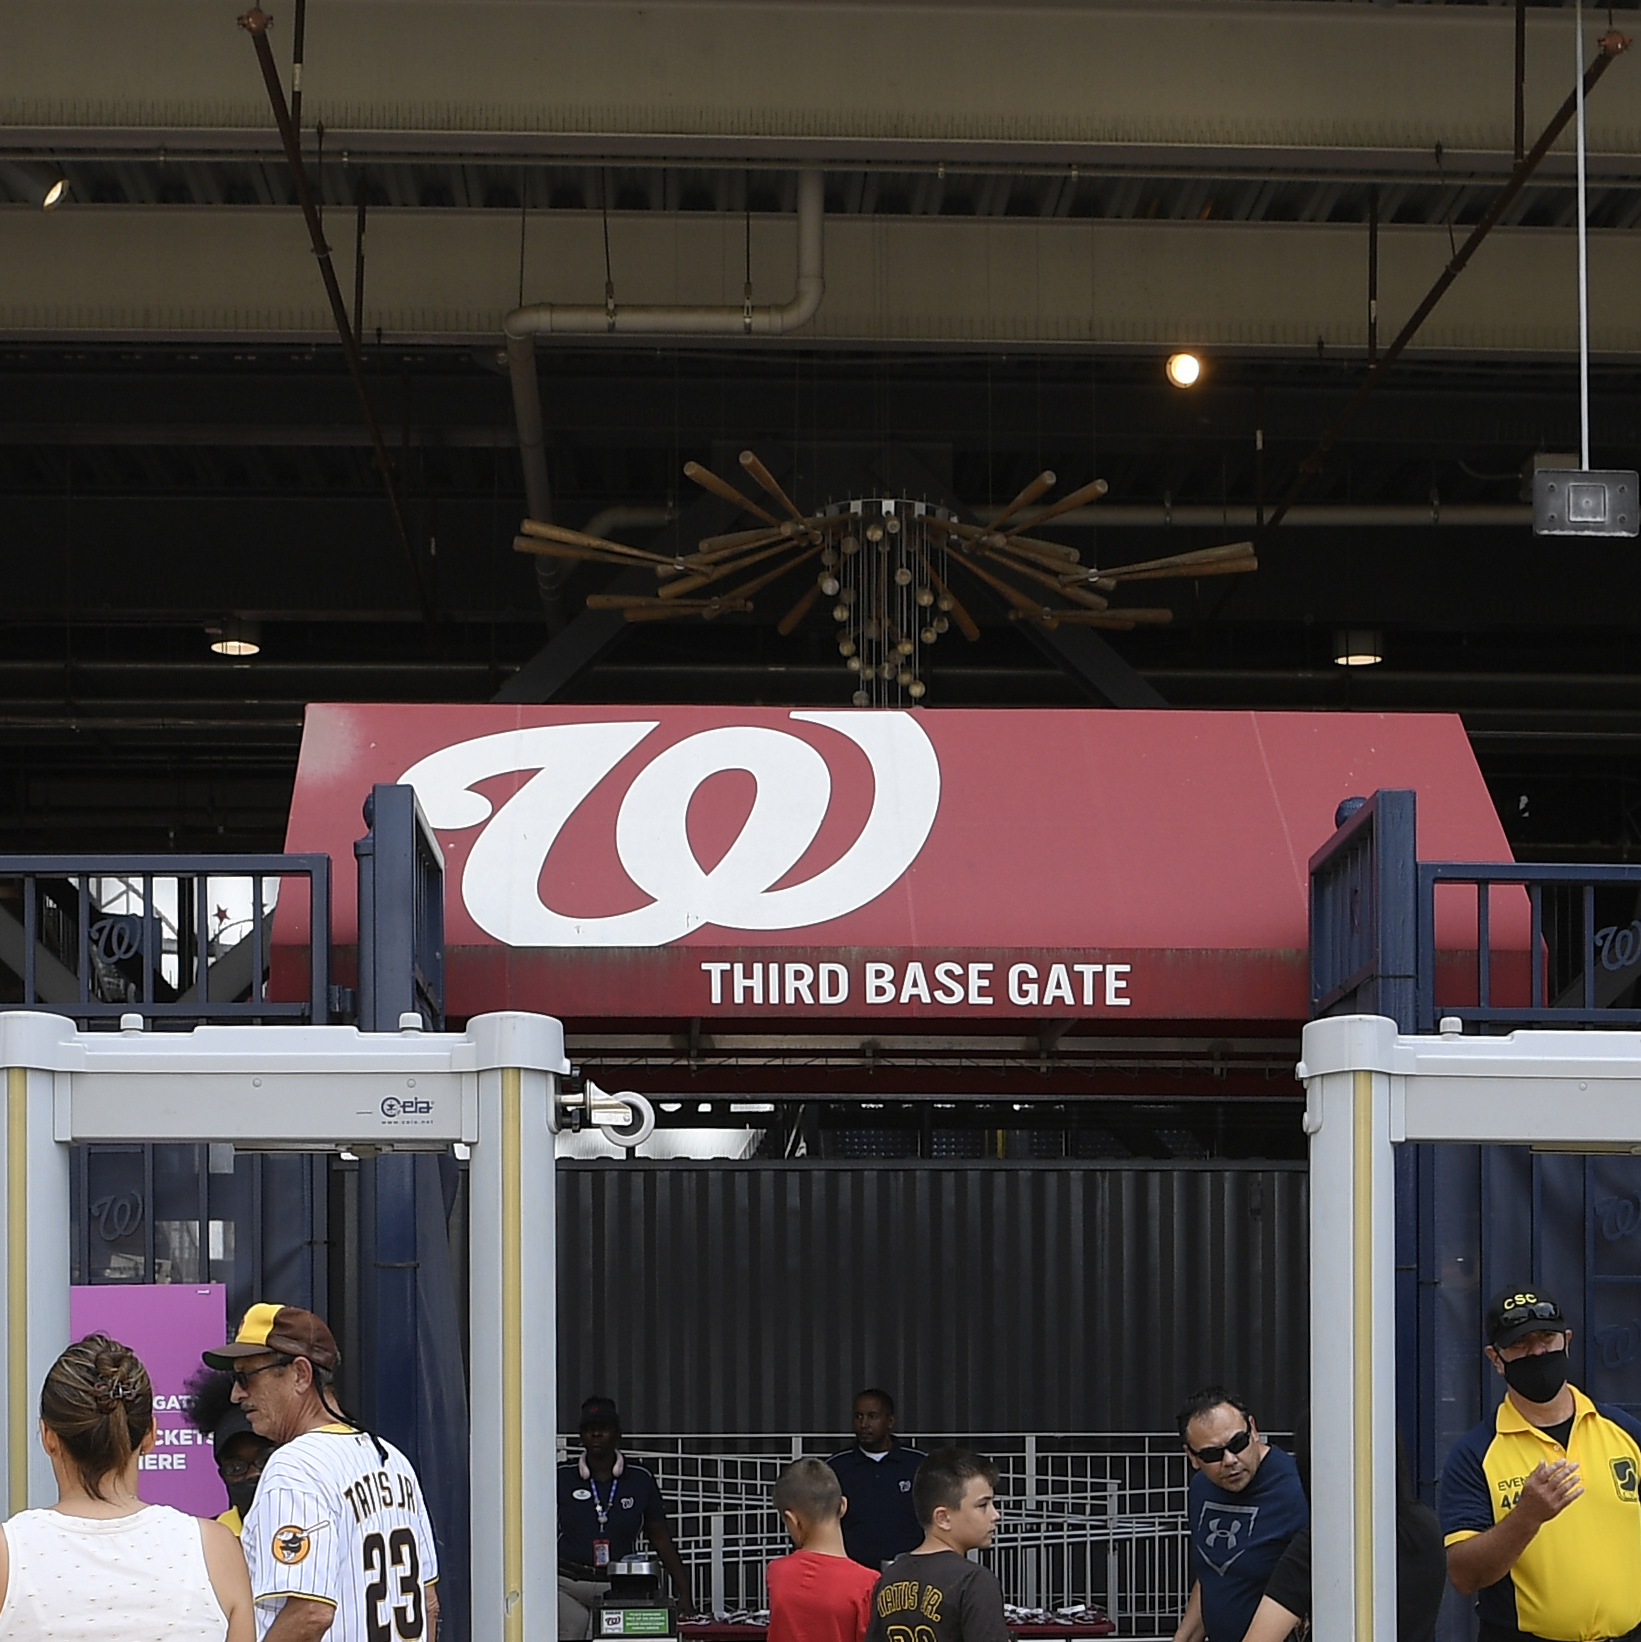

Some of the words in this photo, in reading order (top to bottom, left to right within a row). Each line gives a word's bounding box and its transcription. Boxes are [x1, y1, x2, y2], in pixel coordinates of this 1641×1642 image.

[701, 962, 849, 1006] THIRD
[864, 962, 996, 1007] BASE
[1007, 963, 1132, 1007] GATE
[1504, 1294, 1537, 1310] CSC
[343, 1471, 394, 1525] TATIS
